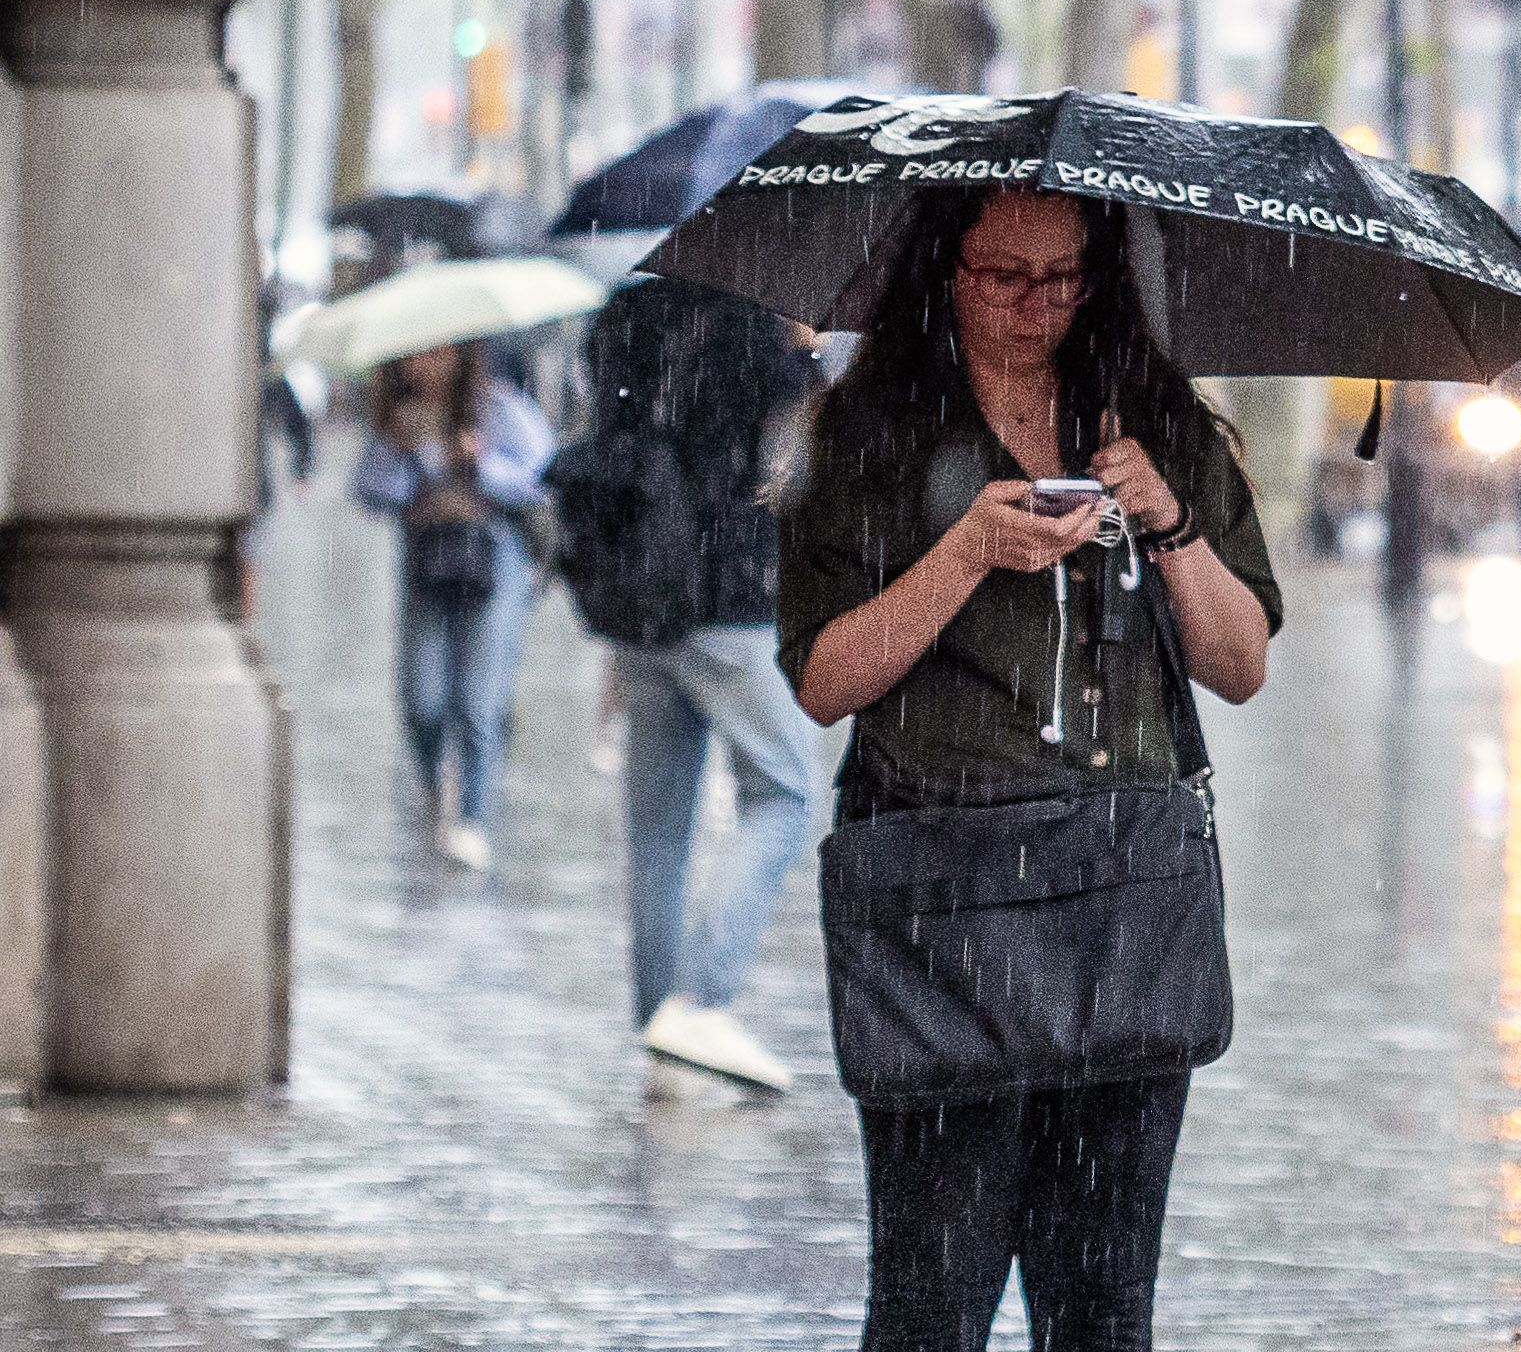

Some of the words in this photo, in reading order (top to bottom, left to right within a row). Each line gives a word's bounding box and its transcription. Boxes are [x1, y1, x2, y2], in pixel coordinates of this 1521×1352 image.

[738, 163, 886, 186] PRAGUE
[899, 158, 1043, 180] PRAGUE
[1055, 161, 1212, 208] PRAGUE
[1234, 192, 1390, 243] PRAGUE
